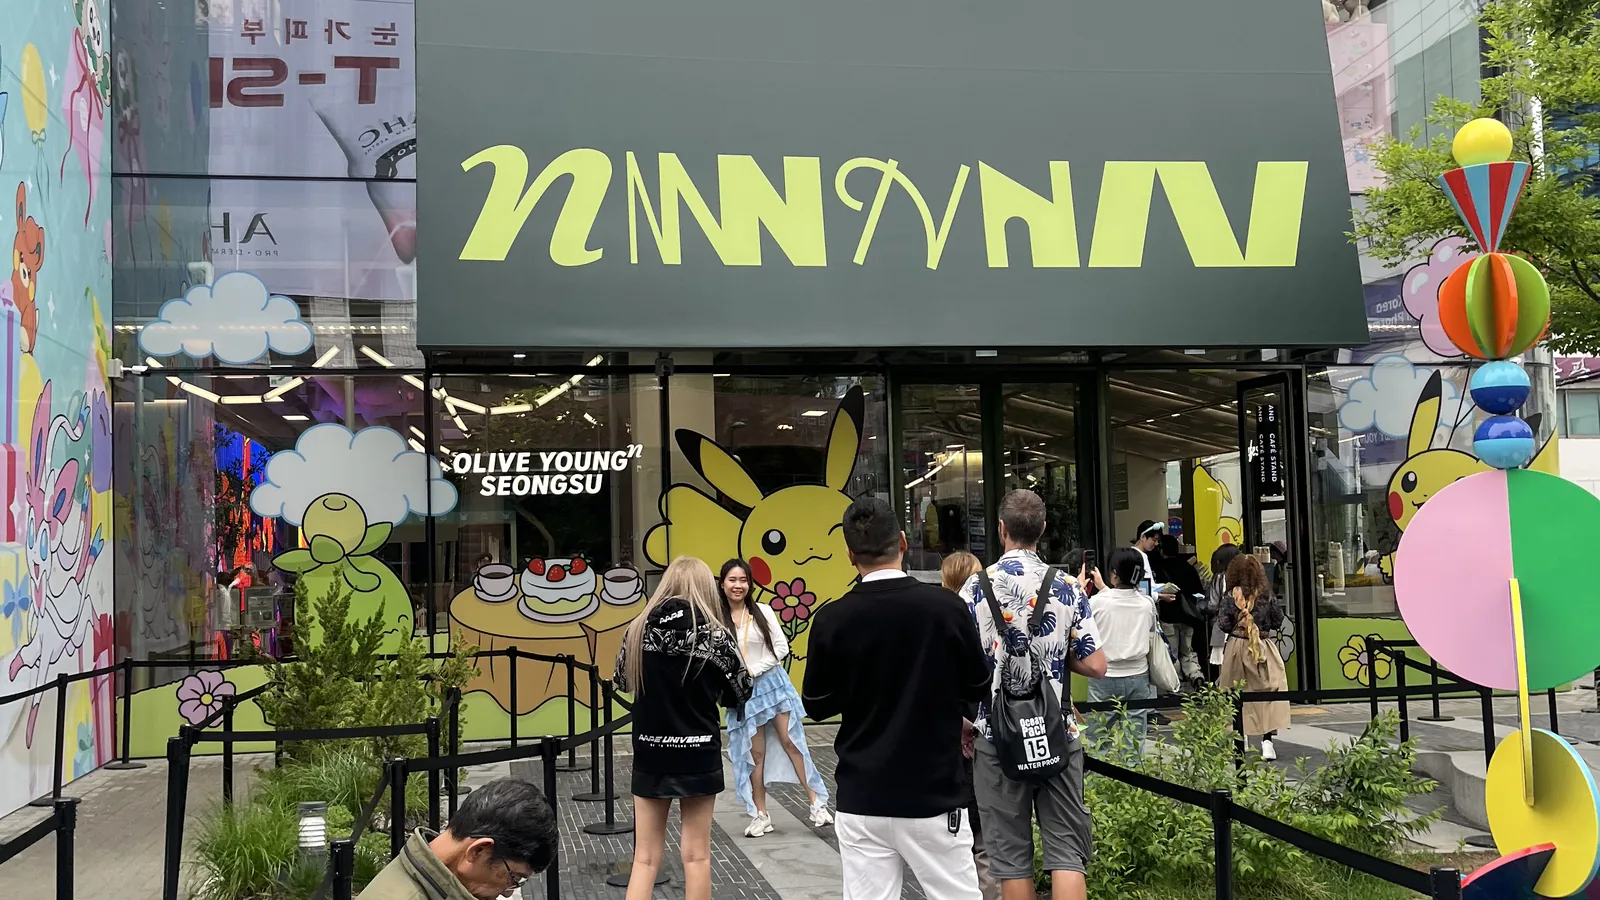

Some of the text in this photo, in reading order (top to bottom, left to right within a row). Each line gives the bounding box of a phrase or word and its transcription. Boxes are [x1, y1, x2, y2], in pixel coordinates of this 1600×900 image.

[453, 451, 531, 474] OLIVE
[1270, 455, 1278, 482] STAND
[479, 473, 603, 497] SEONGSU
[1019, 716, 1045, 728] Ocean
[1021, 723, 1047, 738] Pack
[662, 734, 713, 744] UNIVERSE
[1027, 738, 1047, 759] 15
